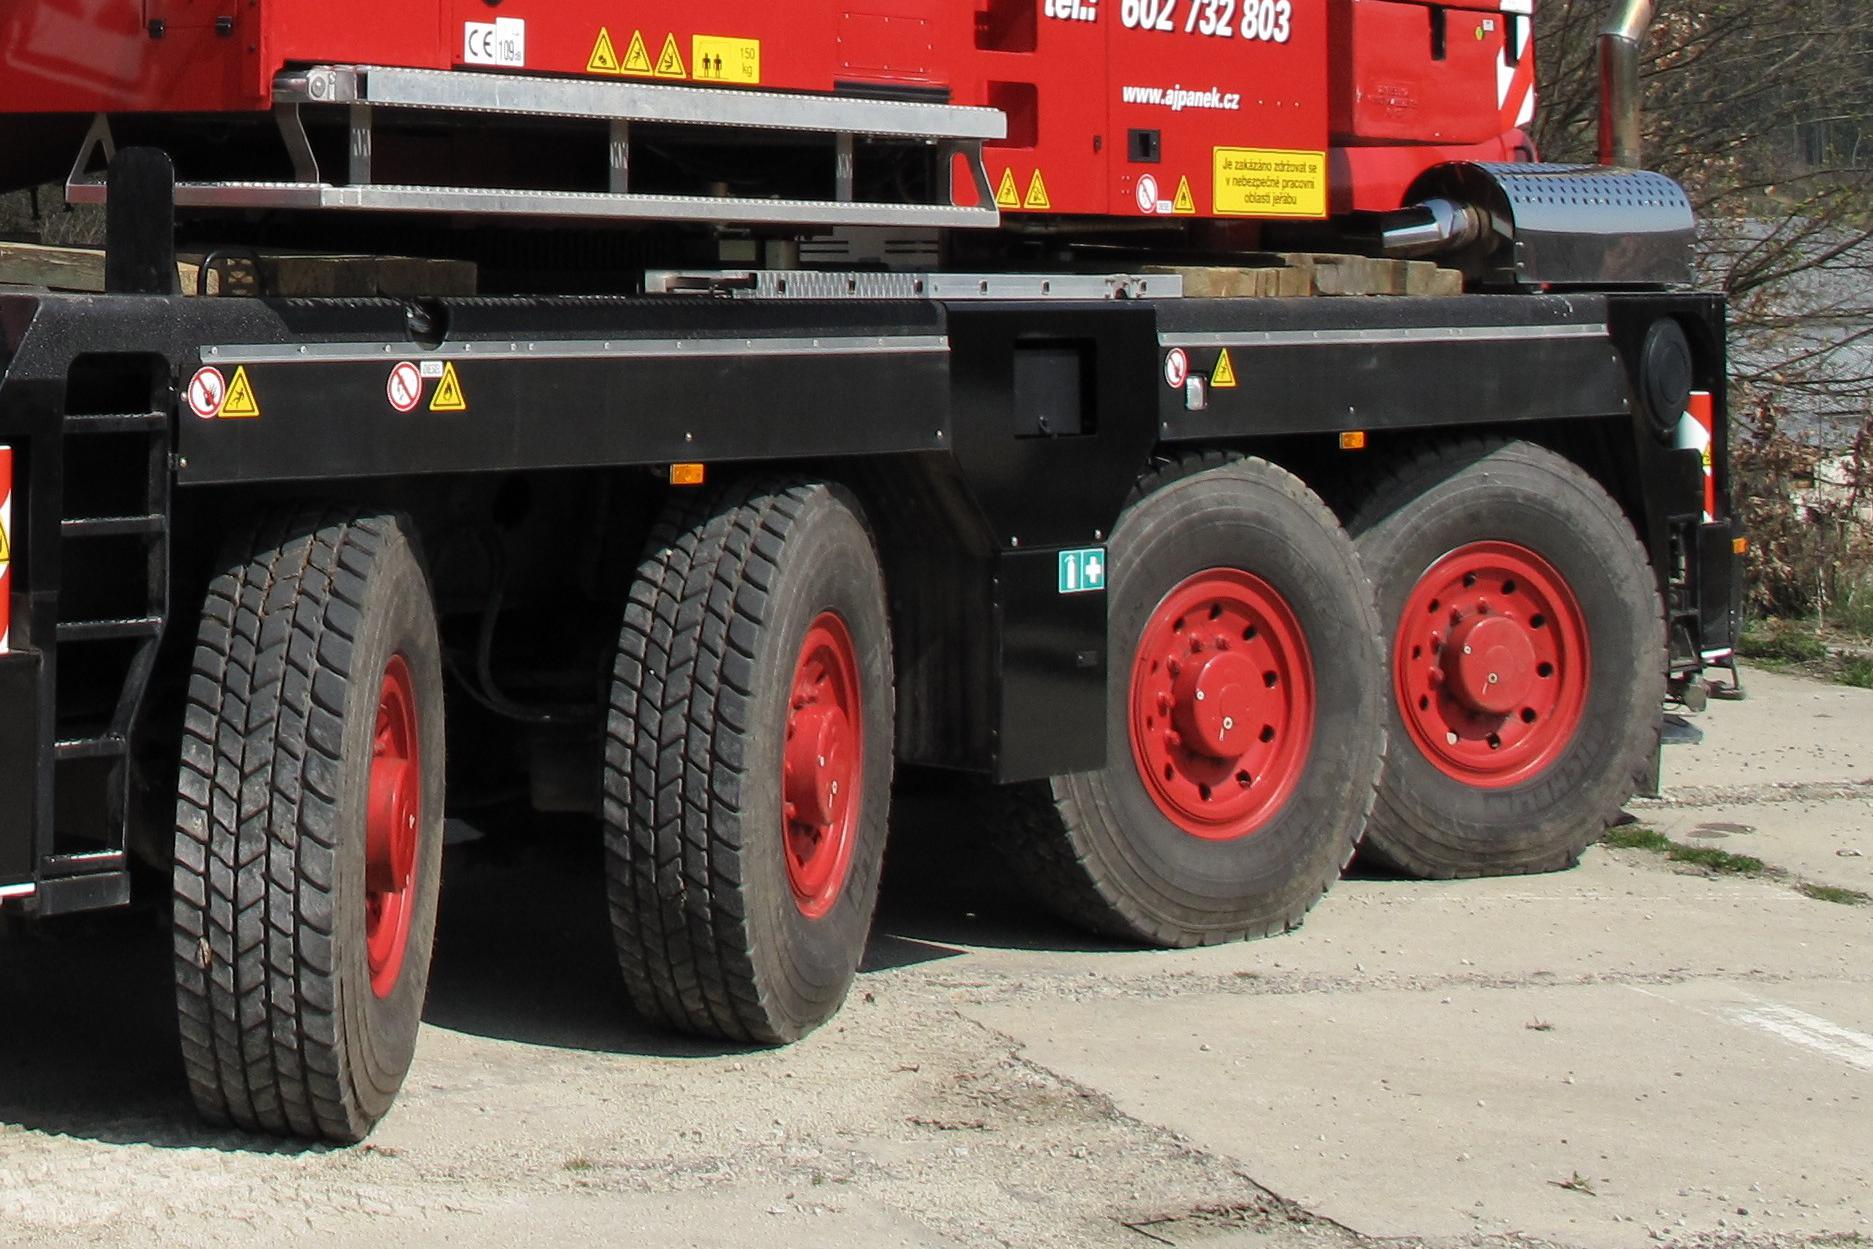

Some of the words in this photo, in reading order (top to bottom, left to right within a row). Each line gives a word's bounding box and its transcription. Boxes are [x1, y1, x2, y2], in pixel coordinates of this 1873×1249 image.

[468, 28, 494, 58] CE
[498, 39, 515, 62] 109
[740, 47, 756, 60] 150
[742, 62, 753, 78] kg
[1122, 83, 1240, 112] www.ajpanek.cz
[1222, 157, 1233, 170] Je
[1308, 164, 1318, 174] se
[1225, 177, 1230, 186] v
